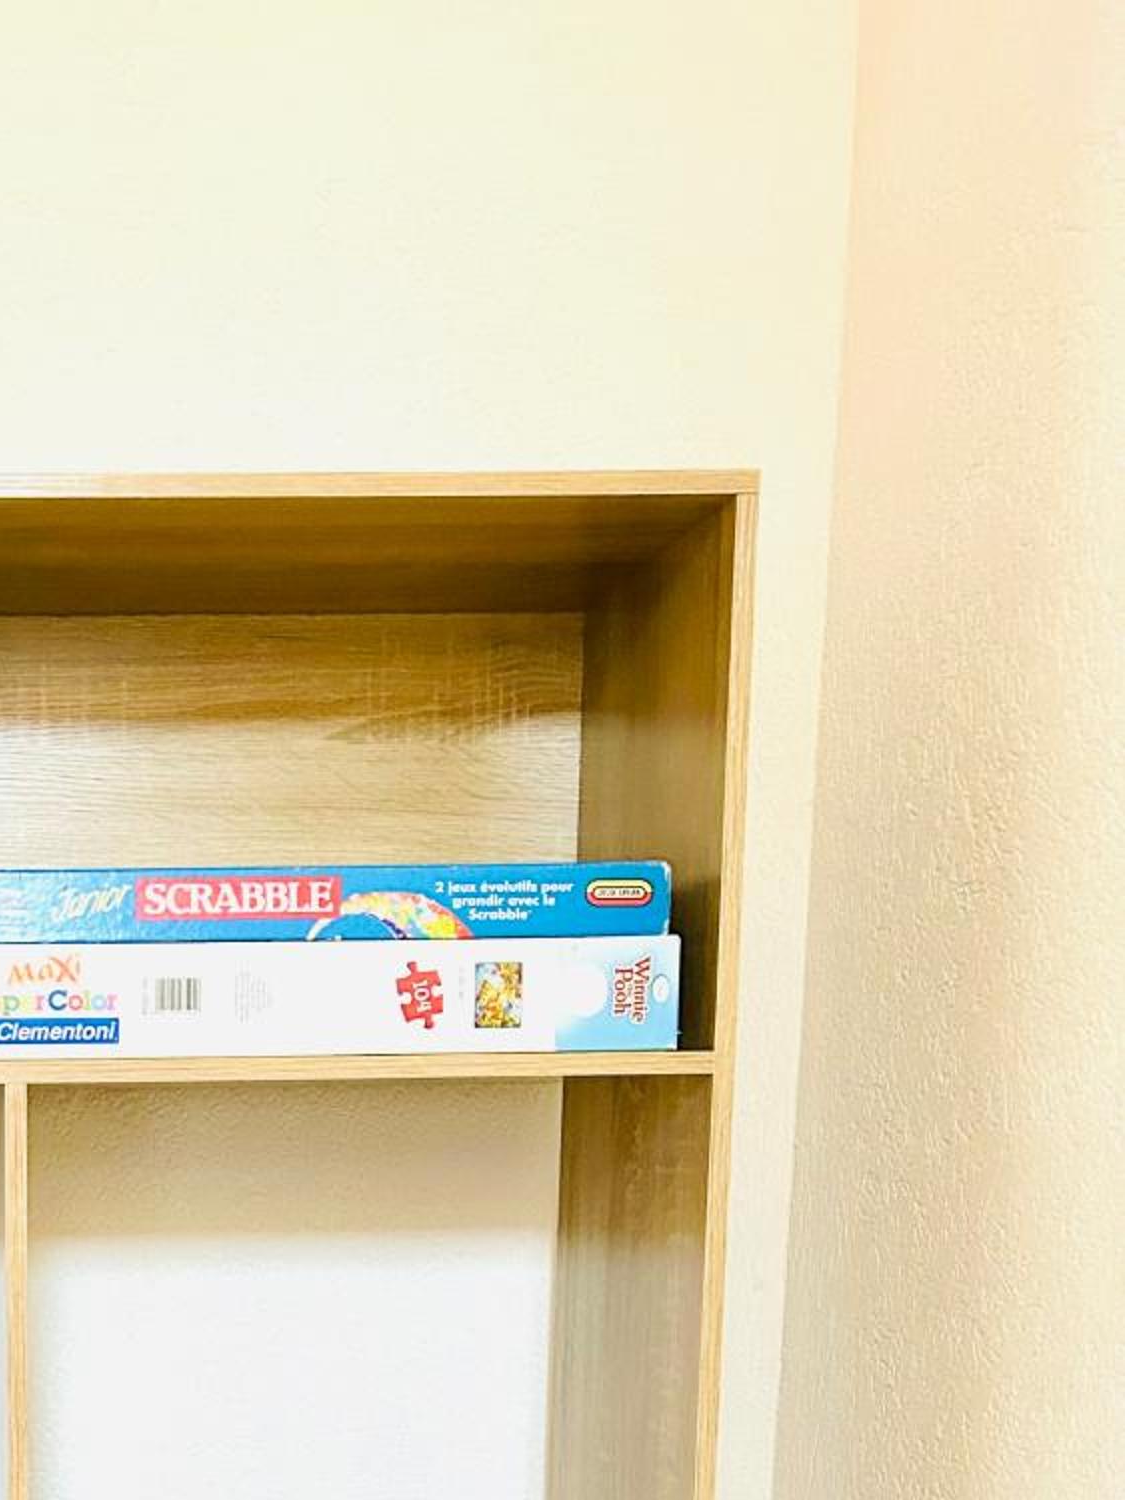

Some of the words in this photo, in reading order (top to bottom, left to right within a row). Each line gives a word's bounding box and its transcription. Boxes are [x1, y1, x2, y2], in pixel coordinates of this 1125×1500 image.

[143, 875, 333, 915] SCRABBLE
[448, 881, 476, 894] jeux
[480, 880, 537, 893] évolutifs
[540, 882, 574, 895] pour
[452, 895, 504, 910] grandir
[507, 895, 539, 908] avec
[542, 893, 556, 906] le
[468, 908, 529, 921] Scrabble
[613, 965, 633, 1016] Pooh
[635, 955, 652, 1022] Winnie
